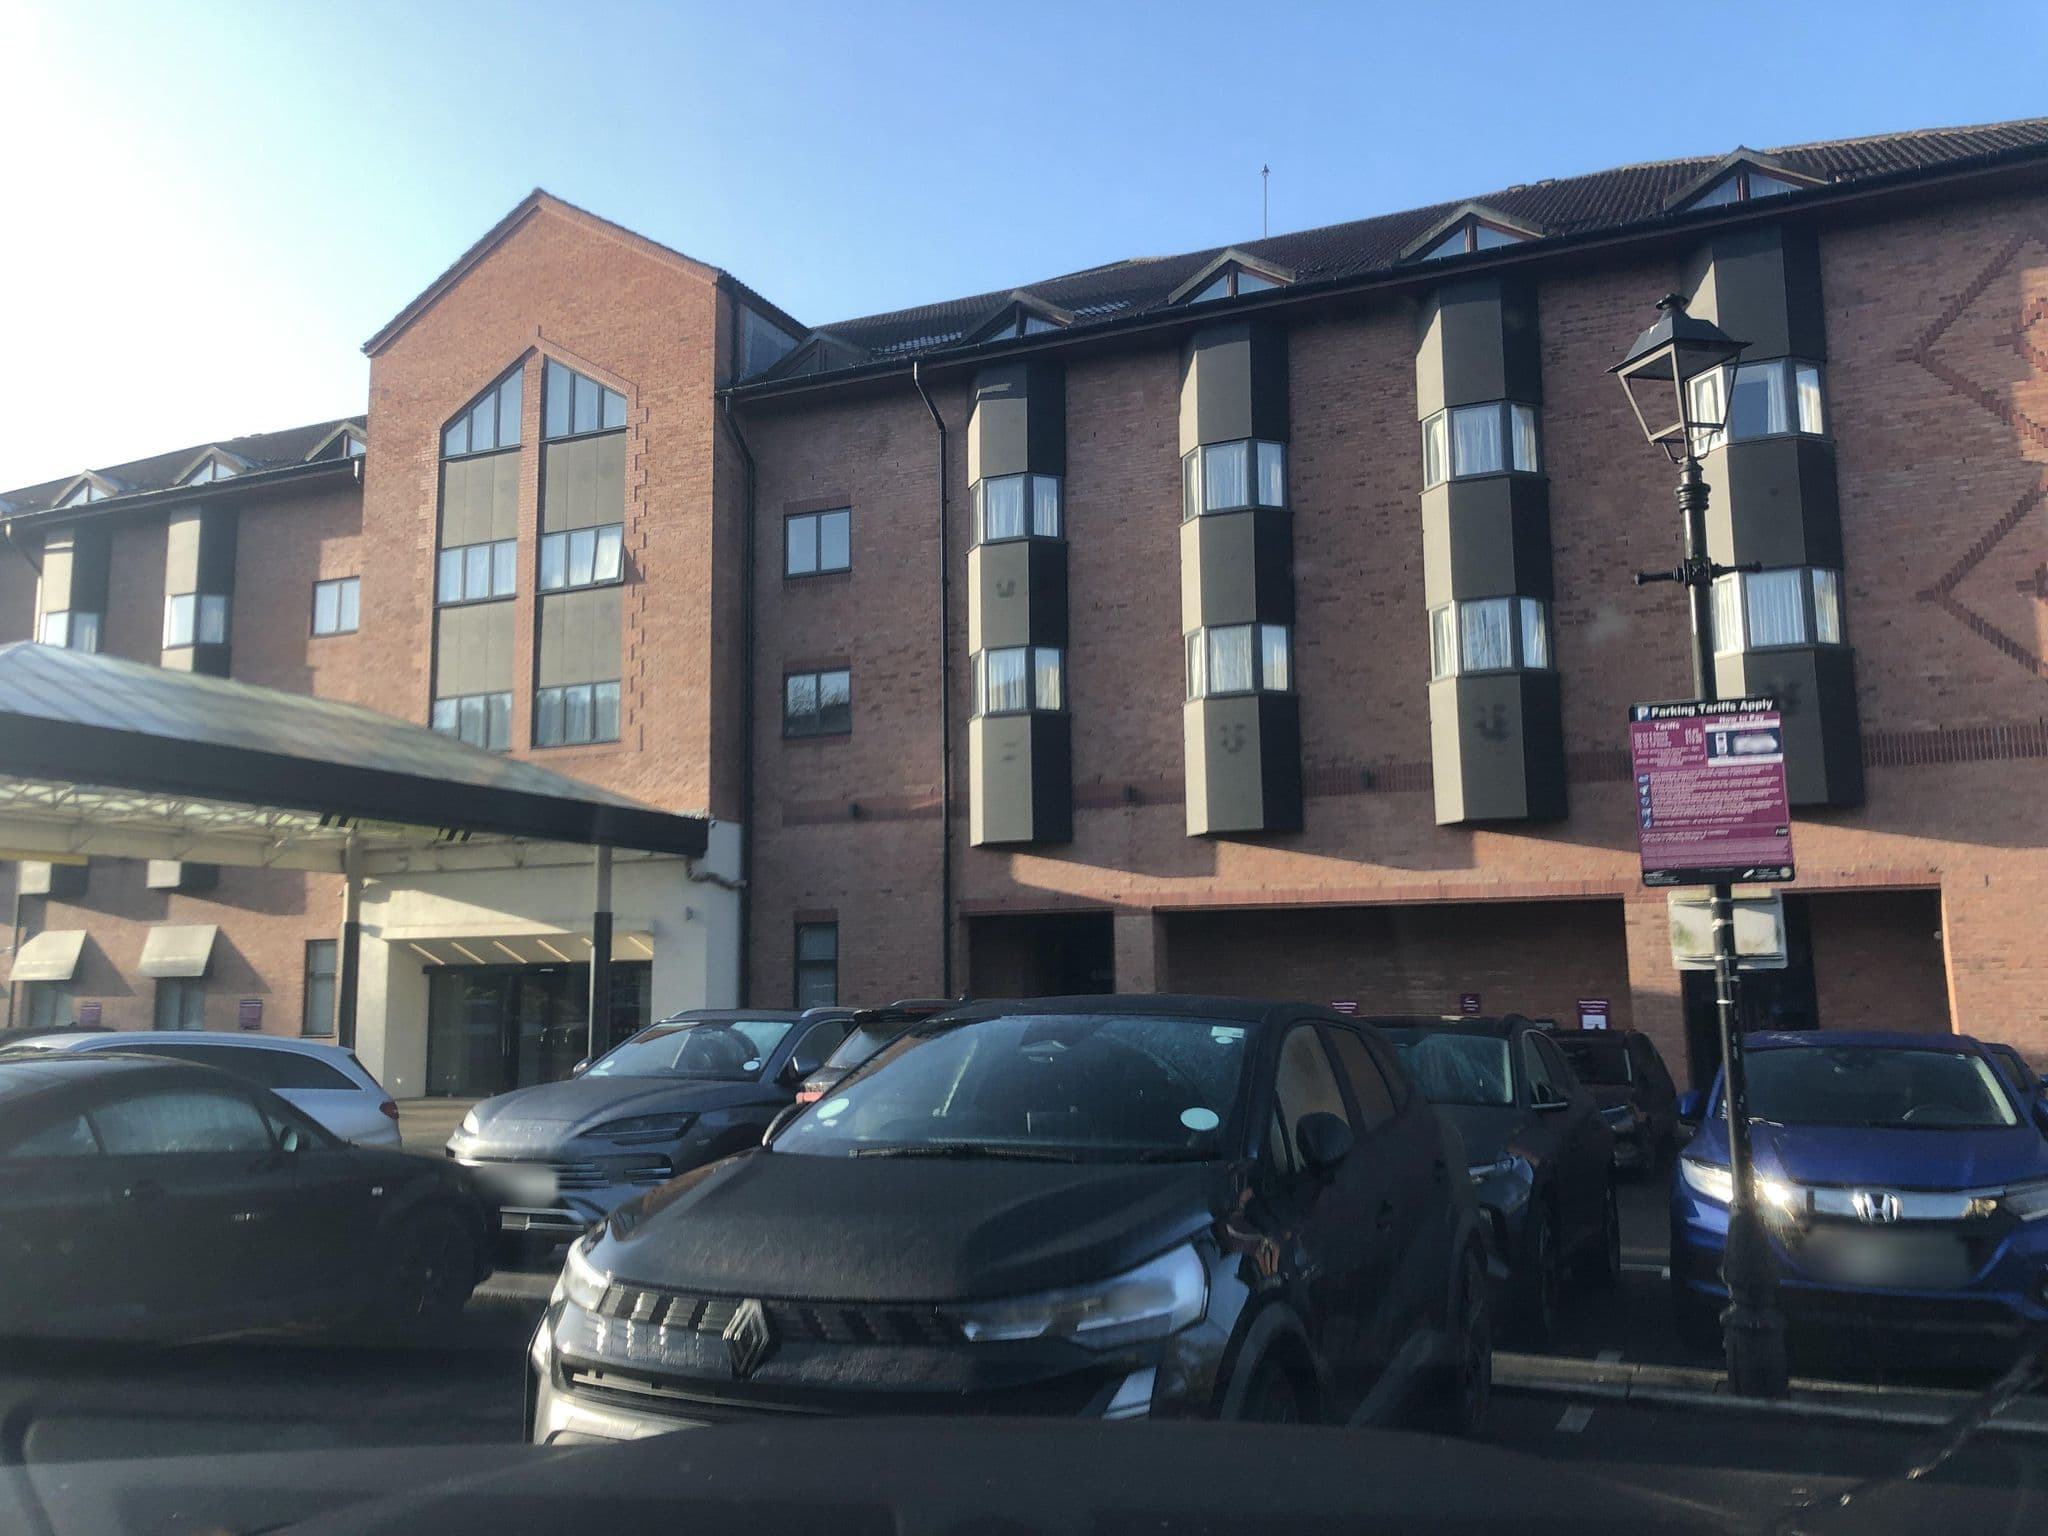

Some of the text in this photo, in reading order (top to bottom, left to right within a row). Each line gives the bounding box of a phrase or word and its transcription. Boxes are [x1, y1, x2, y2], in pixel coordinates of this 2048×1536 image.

[1651, 704, 1695, 718] Parking
[1699, 701, 1736, 715] Tariffs
[1739, 698, 1773, 712] Apply
[1654, 720, 1681, 731] Tariffs
